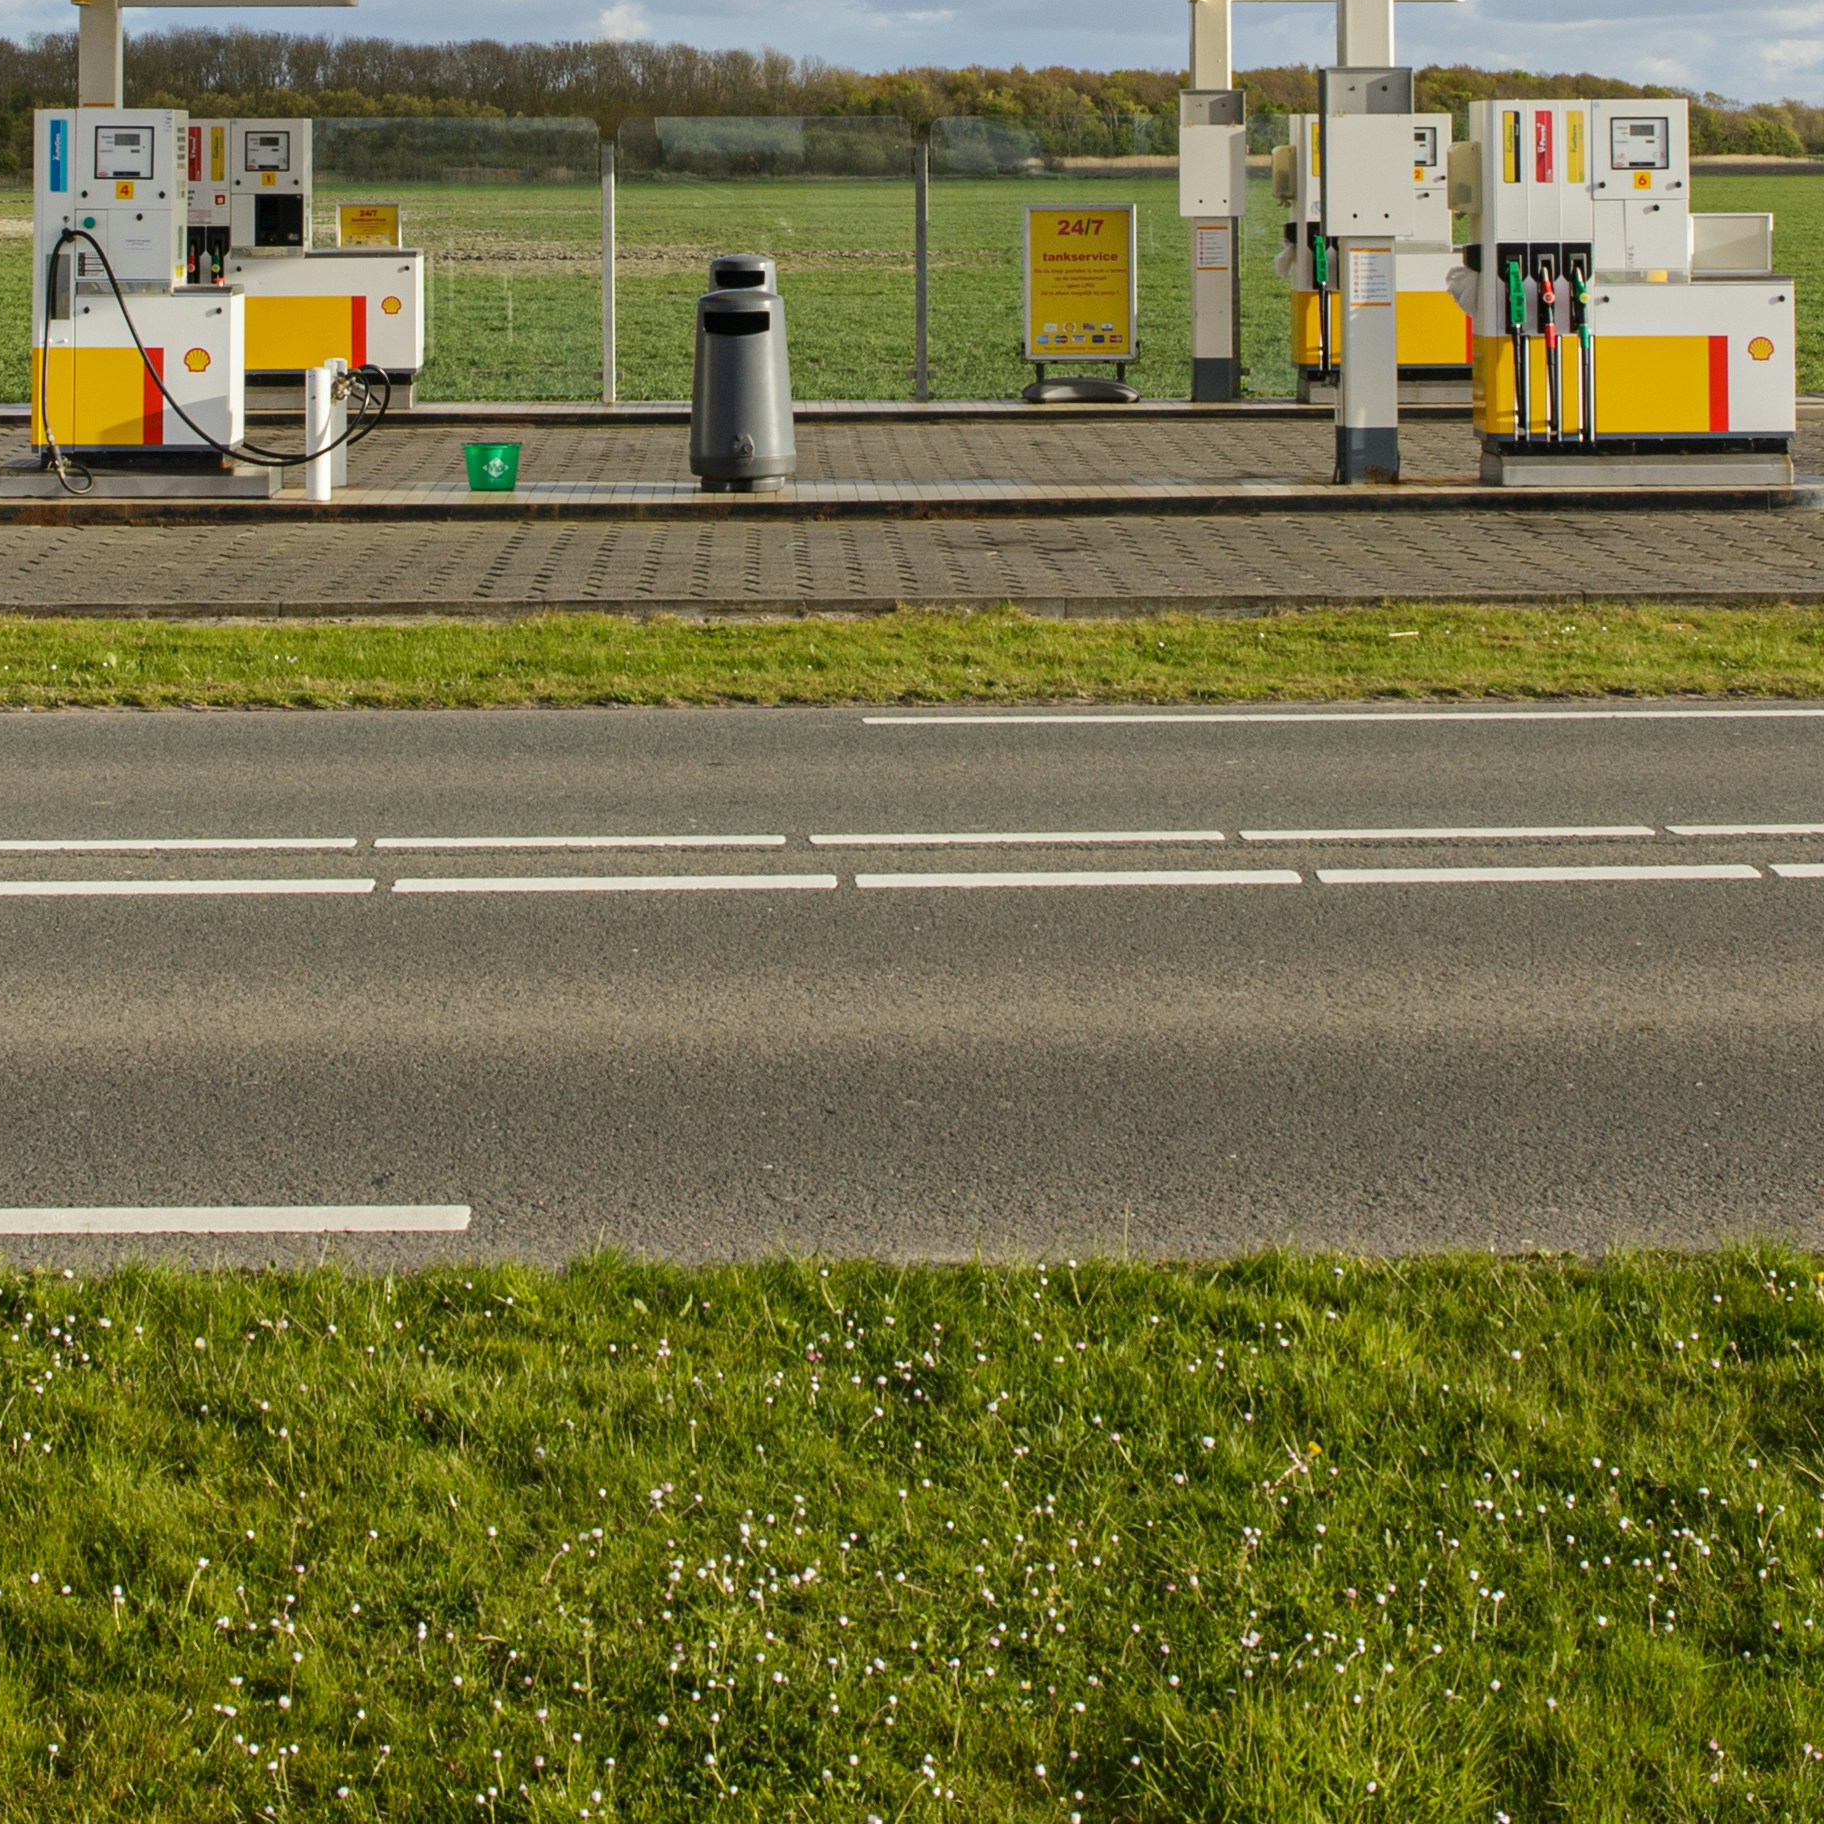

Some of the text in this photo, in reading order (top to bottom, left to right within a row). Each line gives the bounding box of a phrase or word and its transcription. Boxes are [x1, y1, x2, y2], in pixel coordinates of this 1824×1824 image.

[266, 175, 270, 184] 1
[1414, 170, 1421, 179] 2
[1638, 175, 1647, 185] 6
[120, 185, 129, 195] 4
[1057, 218, 1104, 236] 24/7
[1042, 252, 1118, 262] tankservice
